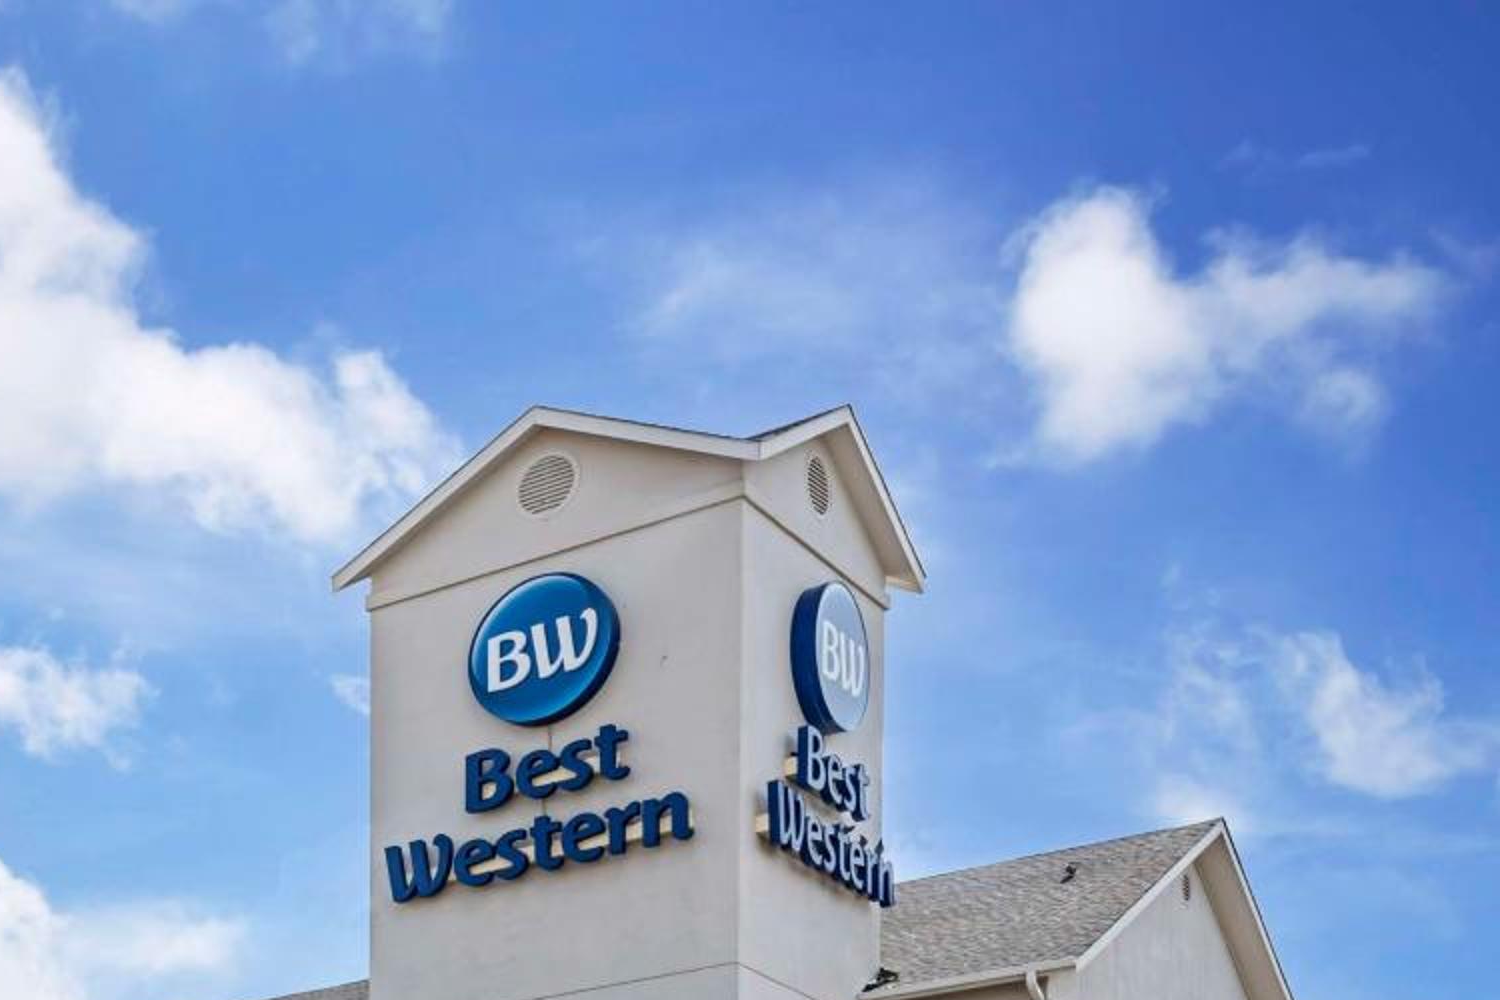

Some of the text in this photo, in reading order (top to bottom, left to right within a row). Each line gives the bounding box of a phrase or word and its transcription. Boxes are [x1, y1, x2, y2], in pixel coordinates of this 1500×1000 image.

[486, 606, 598, 693] BW
[820, 619, 866, 698] BW
[464, 723, 632, 814] Best
[799, 725, 870, 821] Best
[384, 790, 695, 904] Western
[769, 779, 895, 908] Western
